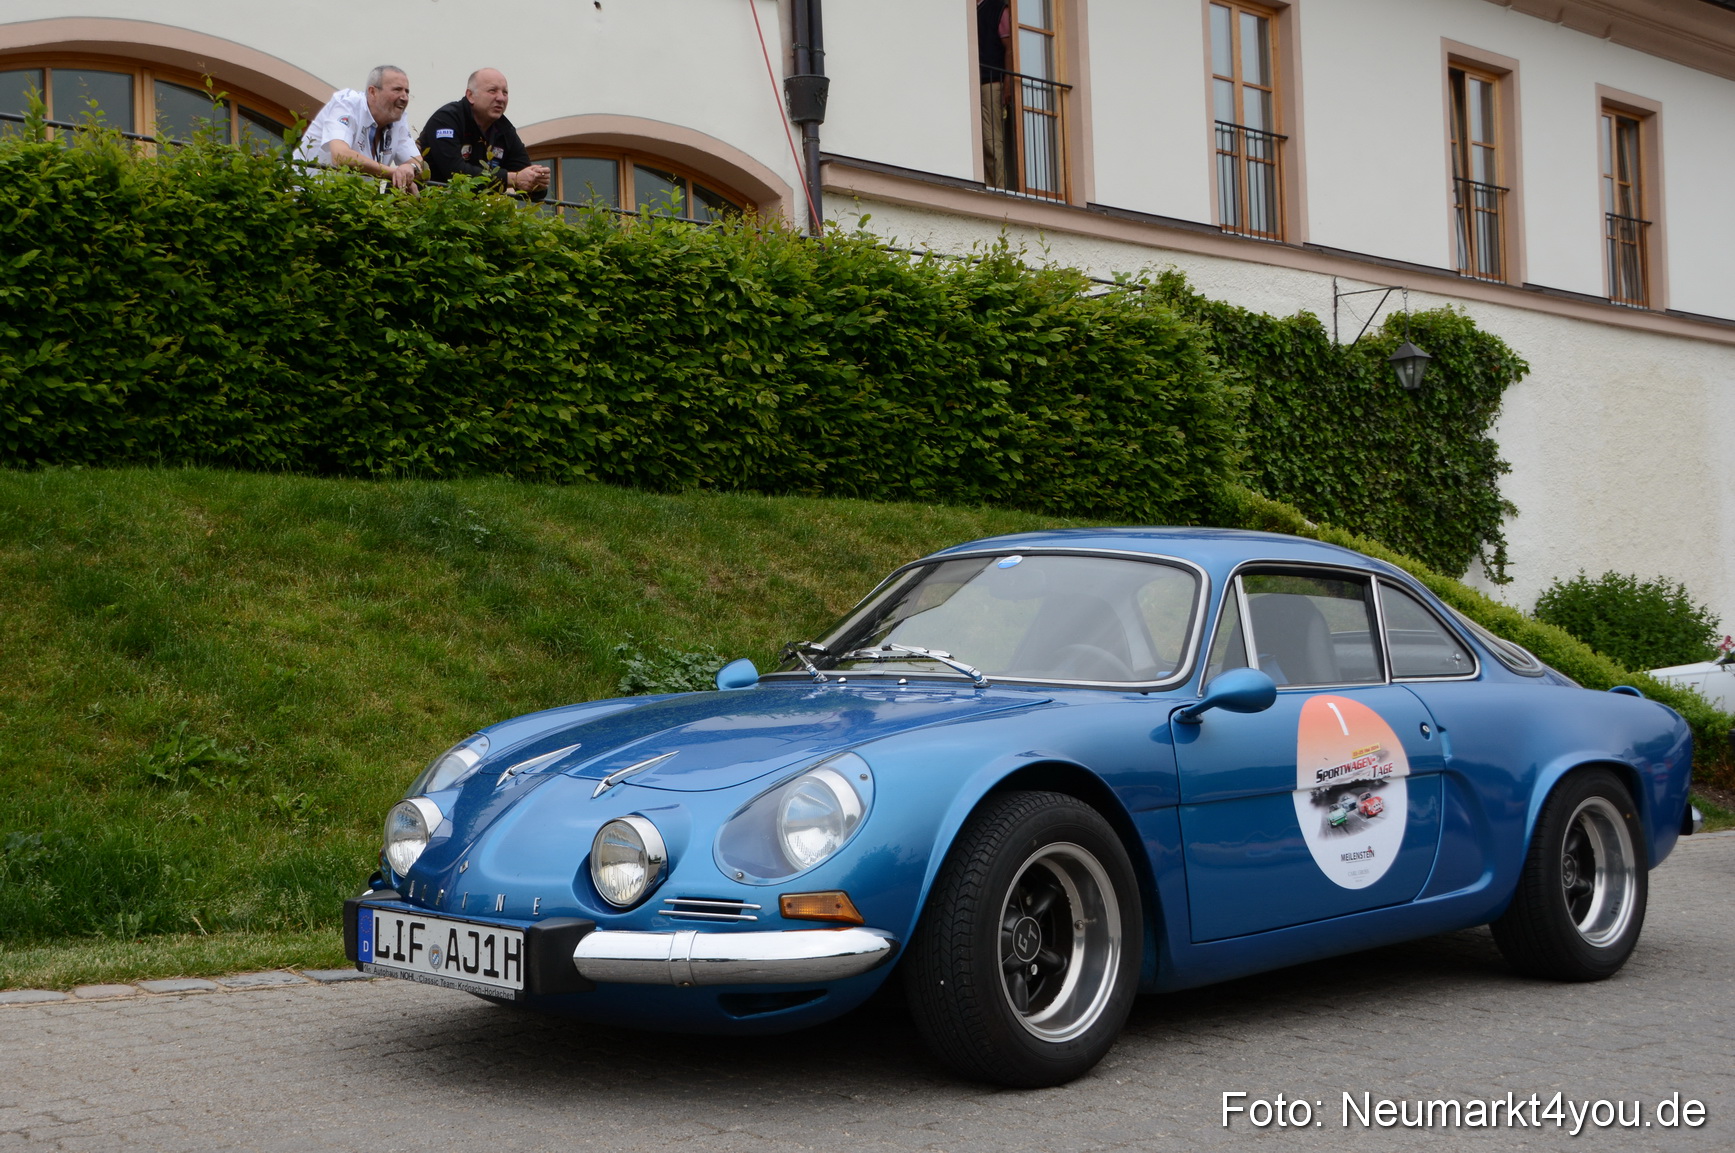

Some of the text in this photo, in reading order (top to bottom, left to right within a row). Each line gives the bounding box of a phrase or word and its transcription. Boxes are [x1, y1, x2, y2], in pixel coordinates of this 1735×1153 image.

[1327, 702, 1349, 736] 1
[1371, 762, 1393, 778] TAGE
[1340, 849, 1375, 862] MEILENSTEIN
[363, 940, 369, 952] D
[1017, 924, 1038, 954] GT
[375, 916, 521, 982] LIF AJ1H
[373, 966, 399, 979] Autohaus
